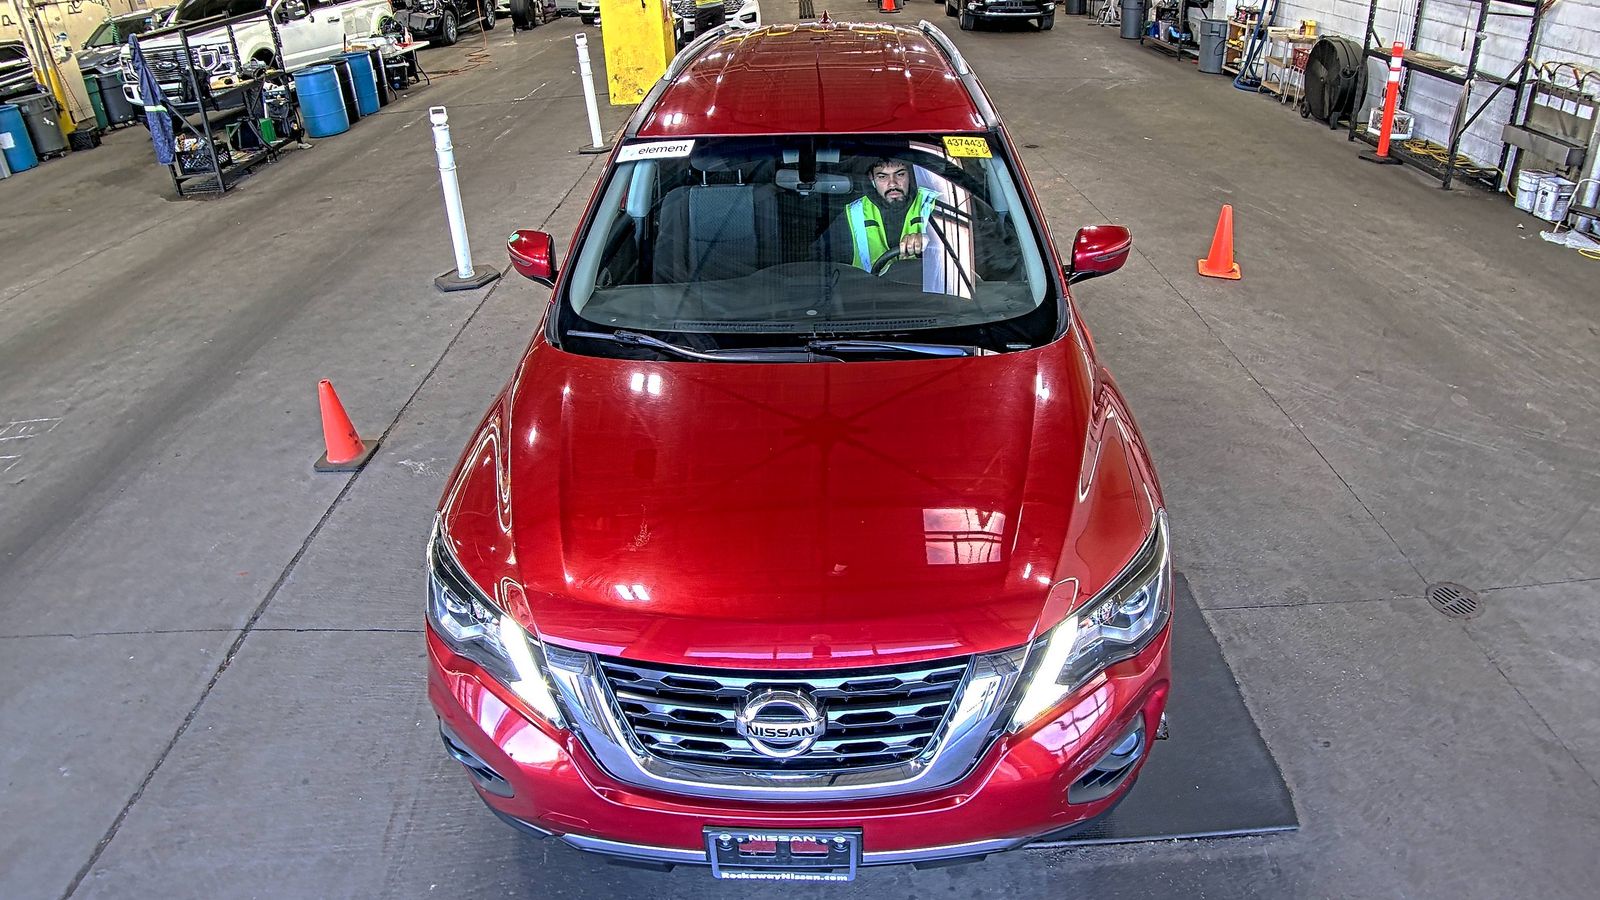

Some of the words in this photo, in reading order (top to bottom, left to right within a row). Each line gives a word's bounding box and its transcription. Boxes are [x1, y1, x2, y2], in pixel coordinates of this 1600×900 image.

[638, 144, 688, 155] element
[746, 725, 815, 738] NISSAN
[748, 834, 817, 842] NISSAN
[721, 872, 848, 881] RockawayNissan.com
